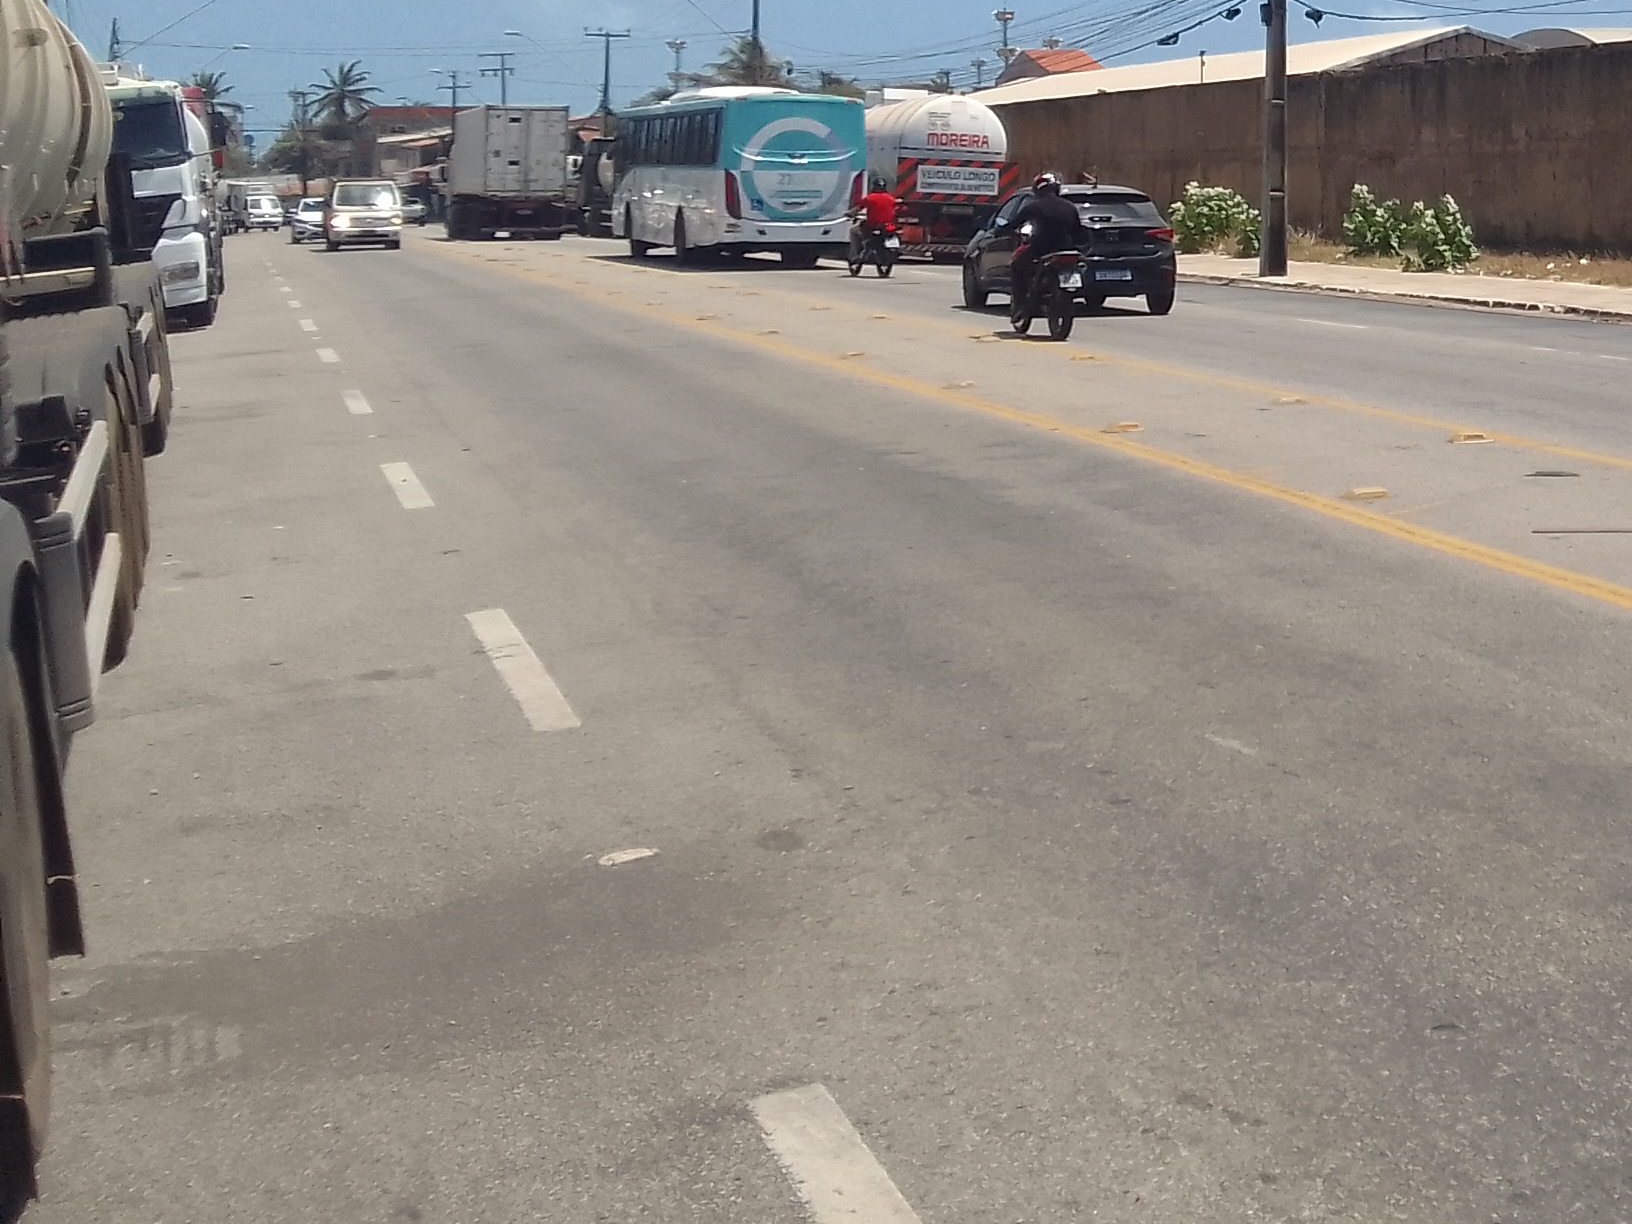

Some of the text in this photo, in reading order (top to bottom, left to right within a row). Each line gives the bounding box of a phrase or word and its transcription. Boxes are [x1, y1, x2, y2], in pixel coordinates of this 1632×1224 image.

[927, 132, 990, 149] MOREIRA
[921, 169, 995, 182] VEICULO LONGO
